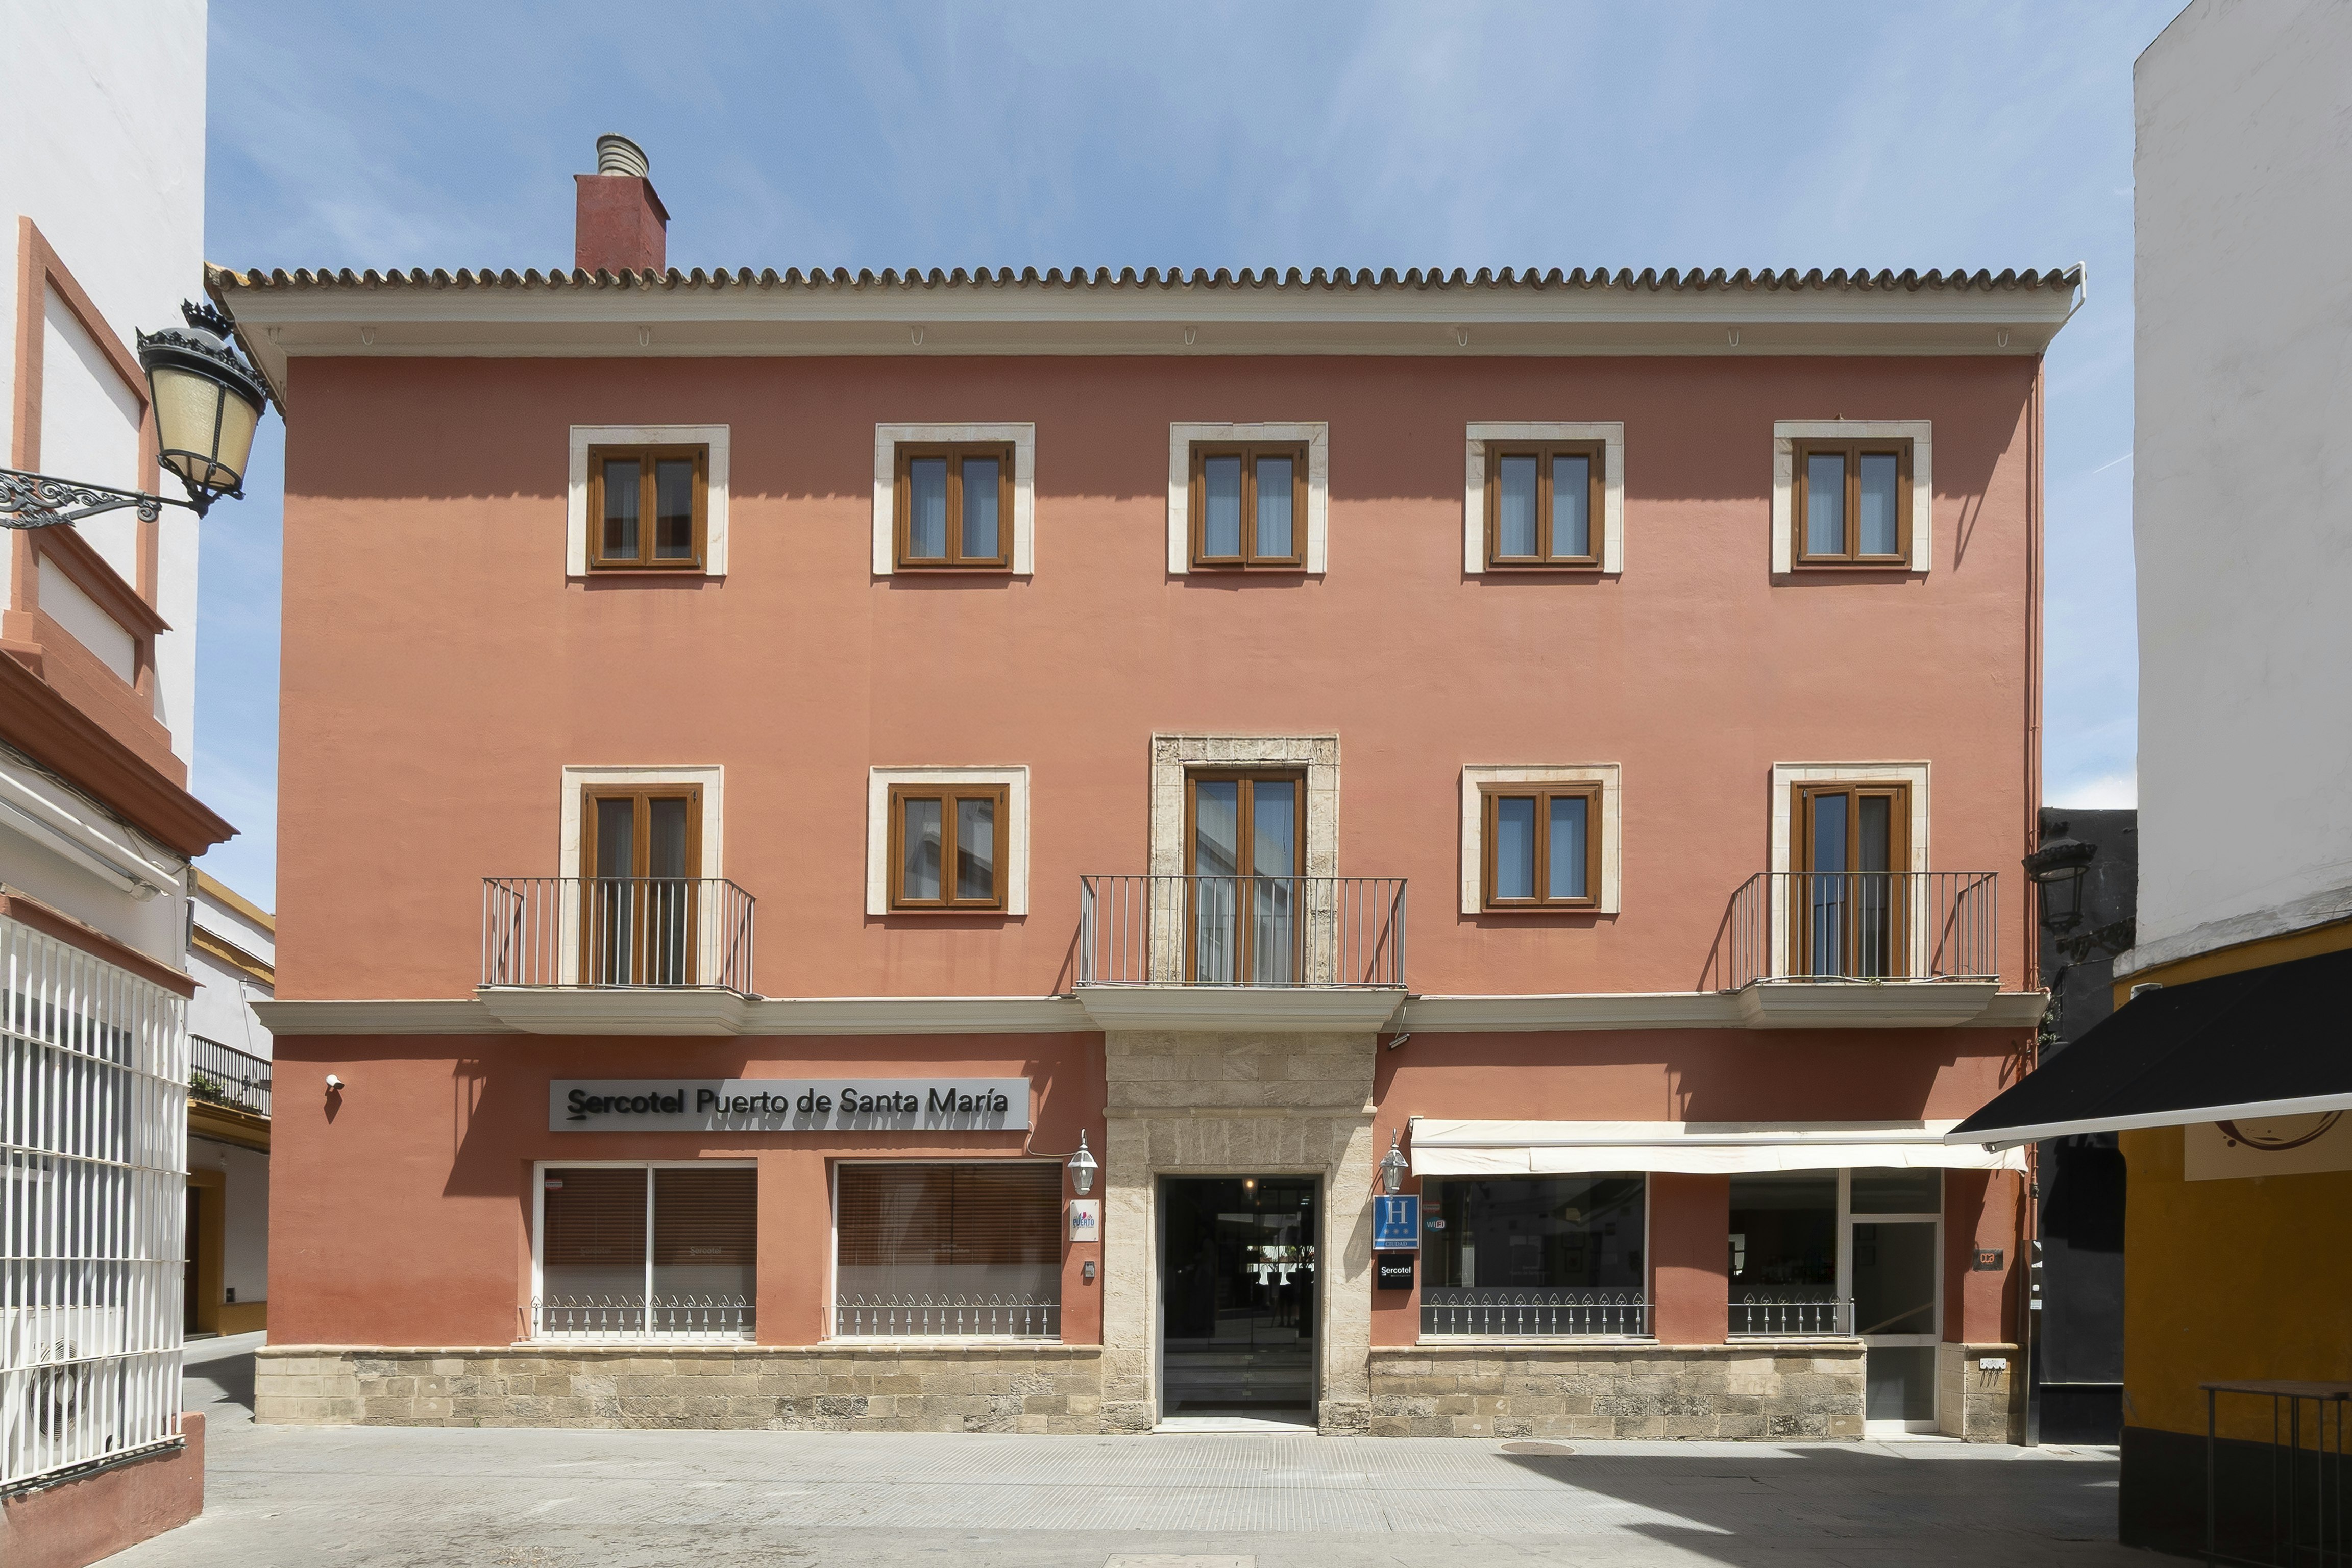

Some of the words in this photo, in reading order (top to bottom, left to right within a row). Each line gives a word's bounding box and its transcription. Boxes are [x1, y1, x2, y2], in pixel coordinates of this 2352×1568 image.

[566, 1088, 684, 1120] Sercotel
[696, 1088, 789, 1114] Puerto
[796, 1088, 832, 1113] de
[840, 1088, 918, 1113] Santa
[928, 1088, 1008, 1112] María
[1386, 1200, 1408, 1224] H
[1381, 1266, 1411, 1276] Sercotel
